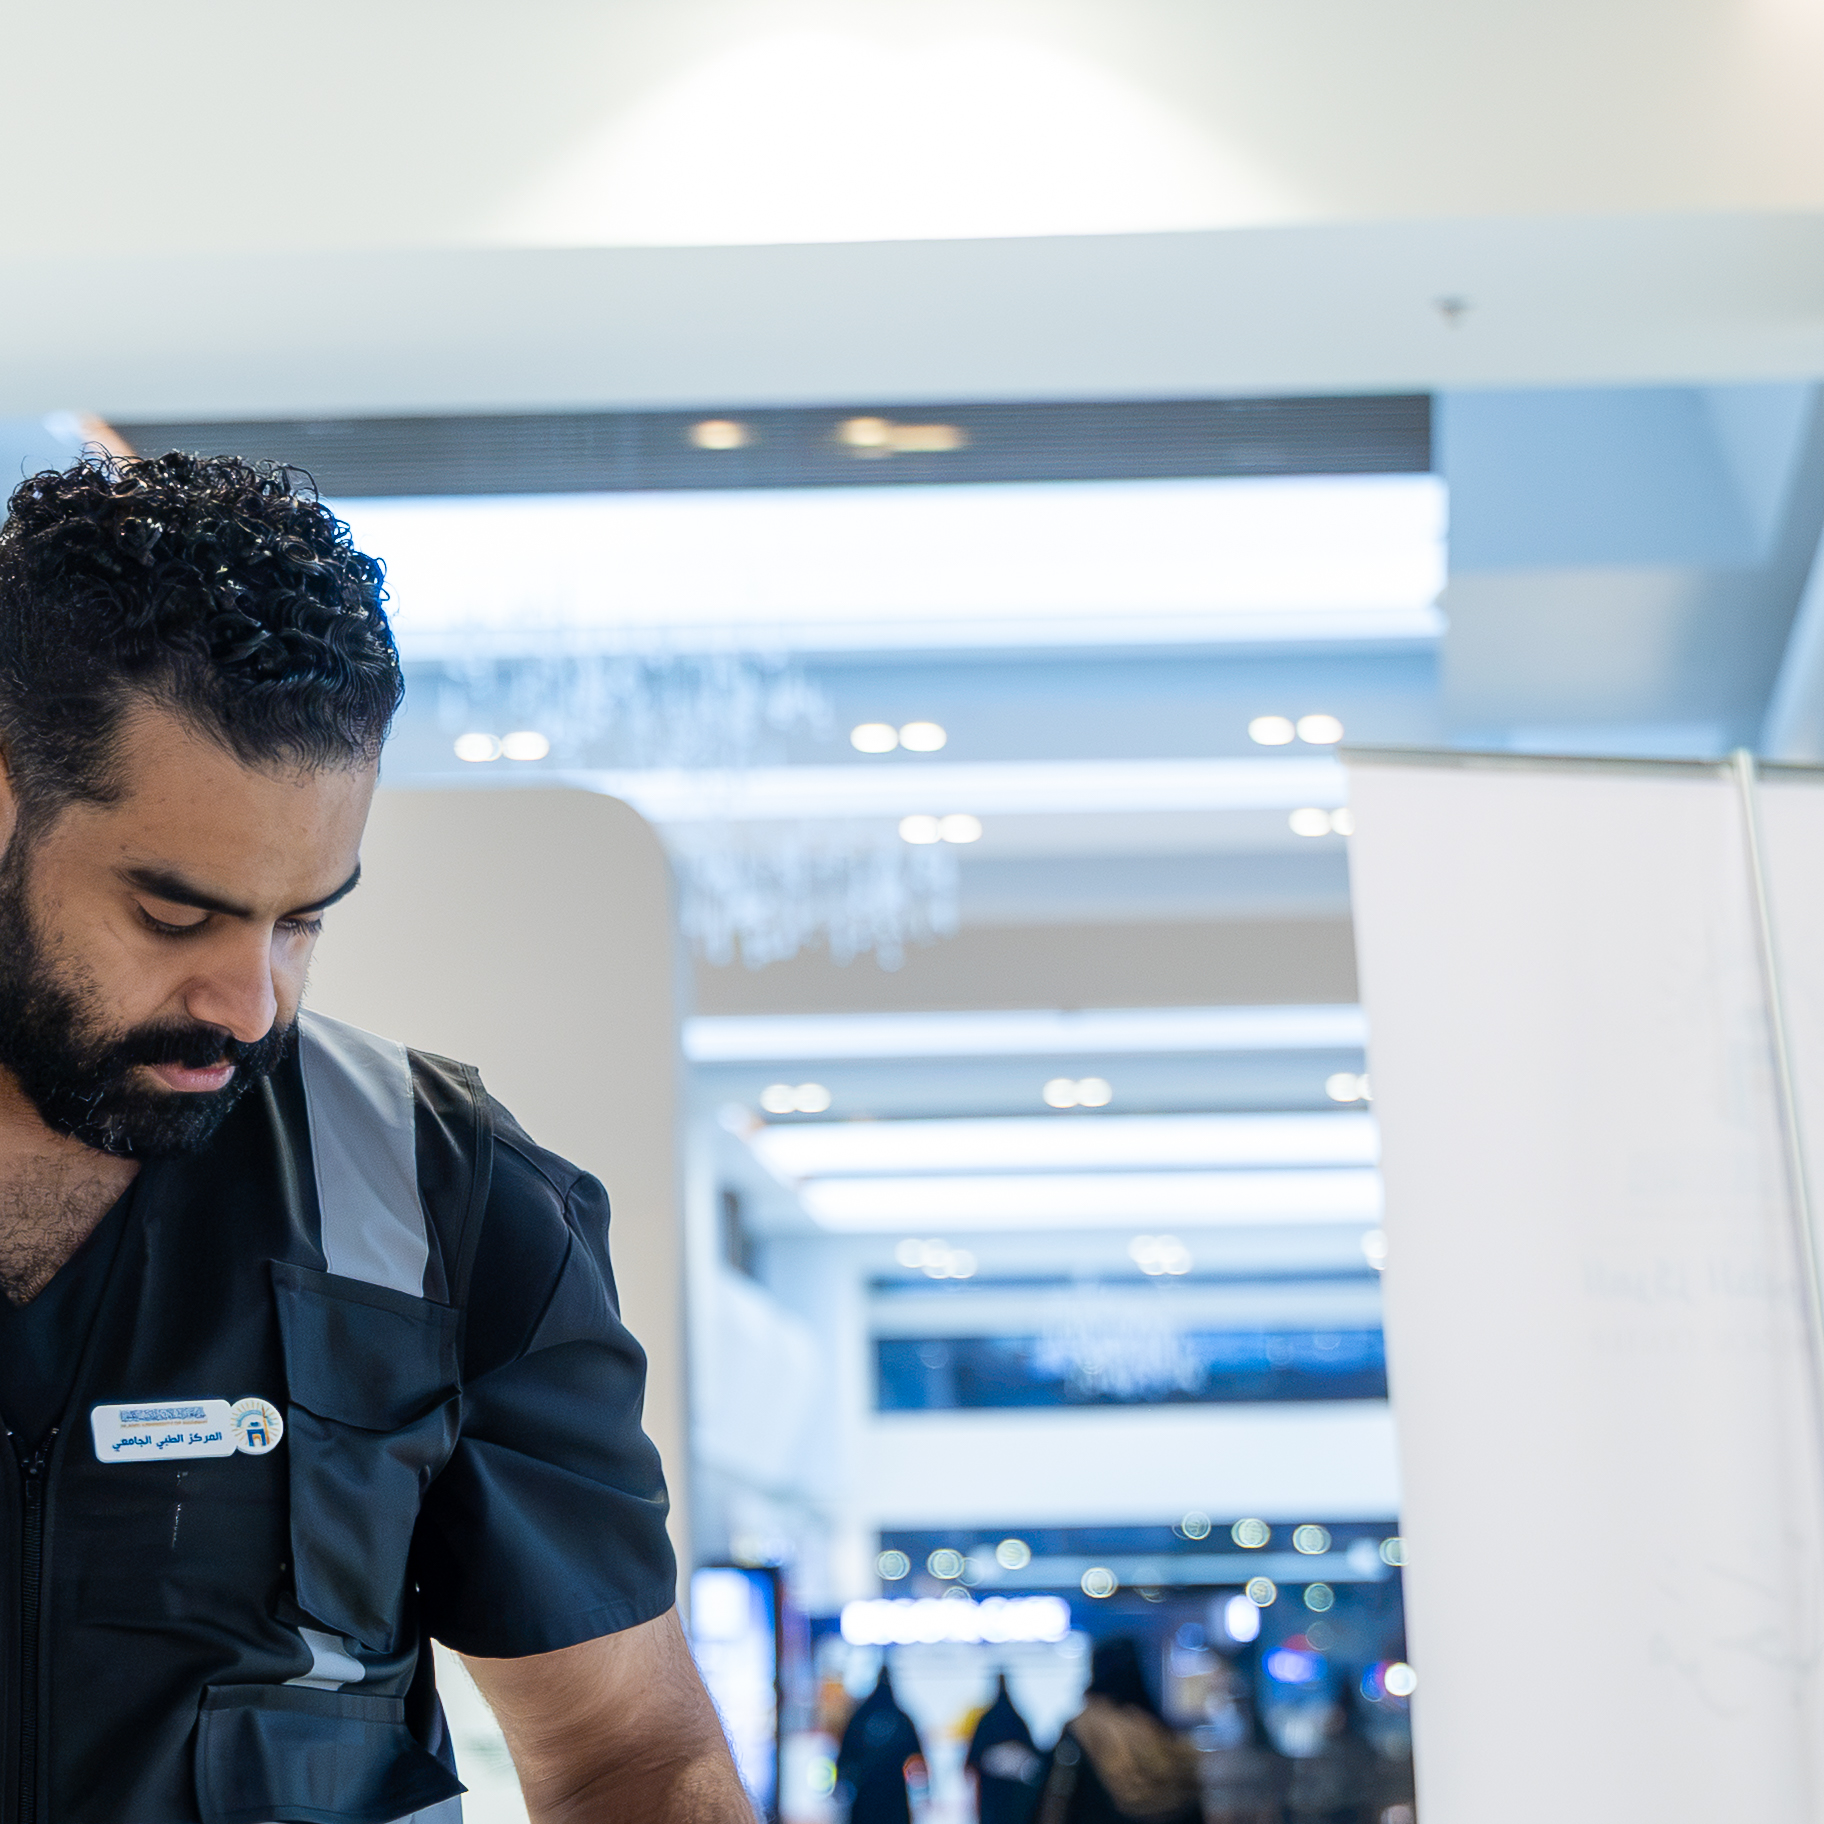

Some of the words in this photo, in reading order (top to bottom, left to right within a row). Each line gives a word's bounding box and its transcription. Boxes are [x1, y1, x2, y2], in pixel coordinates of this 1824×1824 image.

[112, 1435, 152, 1451] الجامعي
[156, 1434, 184, 1450] الطبي
[188, 1431, 223, 1446] المركز
